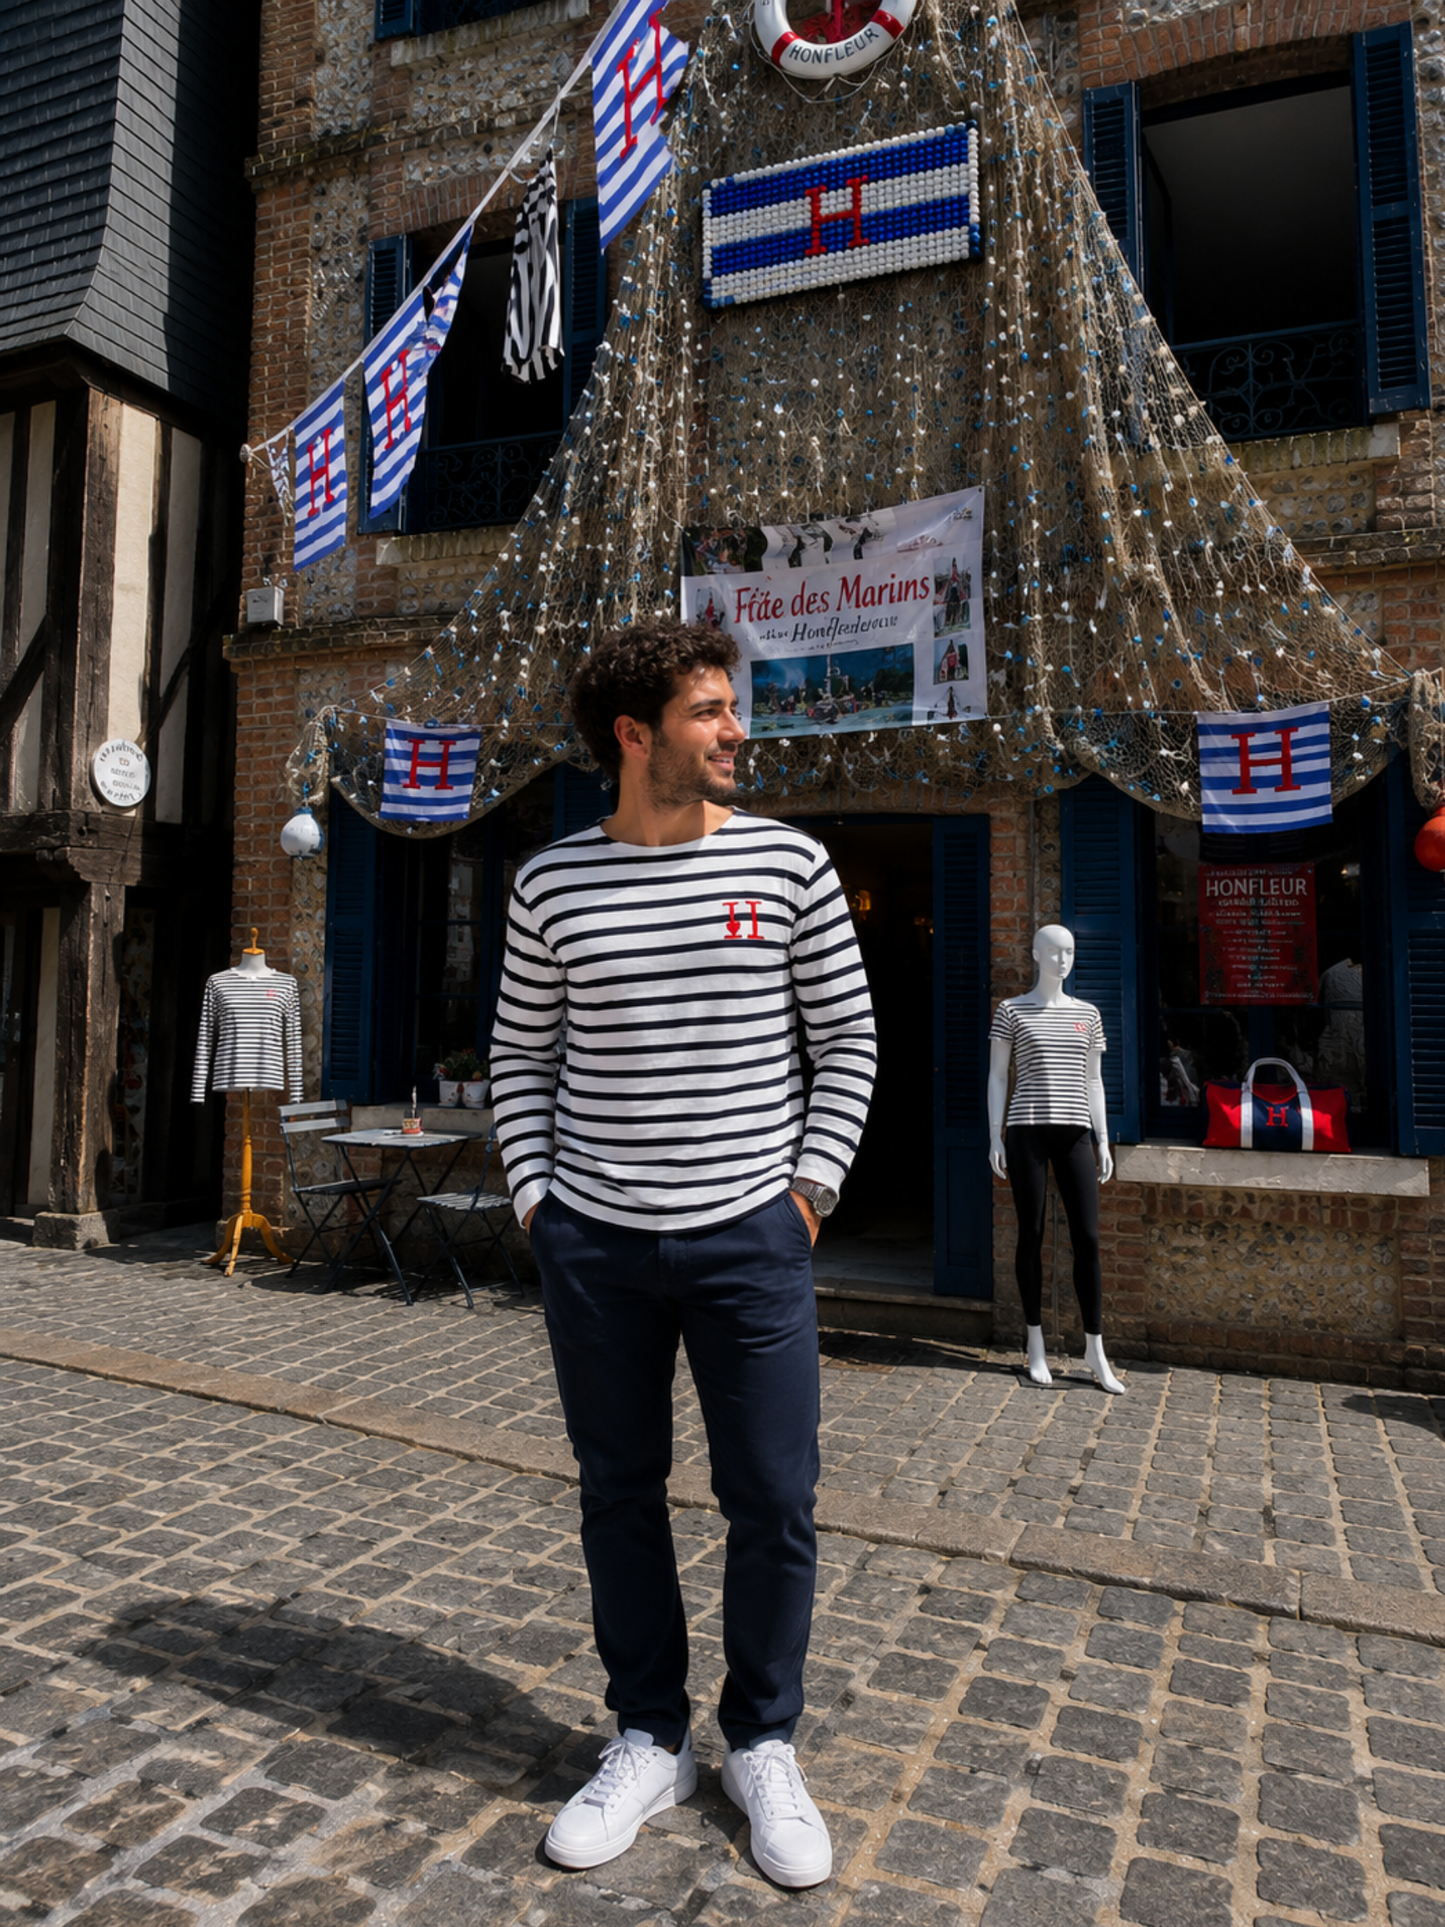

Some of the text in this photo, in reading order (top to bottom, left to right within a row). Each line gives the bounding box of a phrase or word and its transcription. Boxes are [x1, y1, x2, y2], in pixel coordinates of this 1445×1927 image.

[789, 28, 880, 64] HONFLEUR
[617, 7, 668, 159] H
[805, 175, 869, 256] H
[381, 349, 411, 450] H
[307, 427, 335, 518] H
[791, 580, 830, 616] des
[402, 738, 456, 790] H
[1231, 727, 1301, 795] H
[1206, 878, 1308, 897] HONFLEUR
[1265, 1105, 1289, 1128] H
